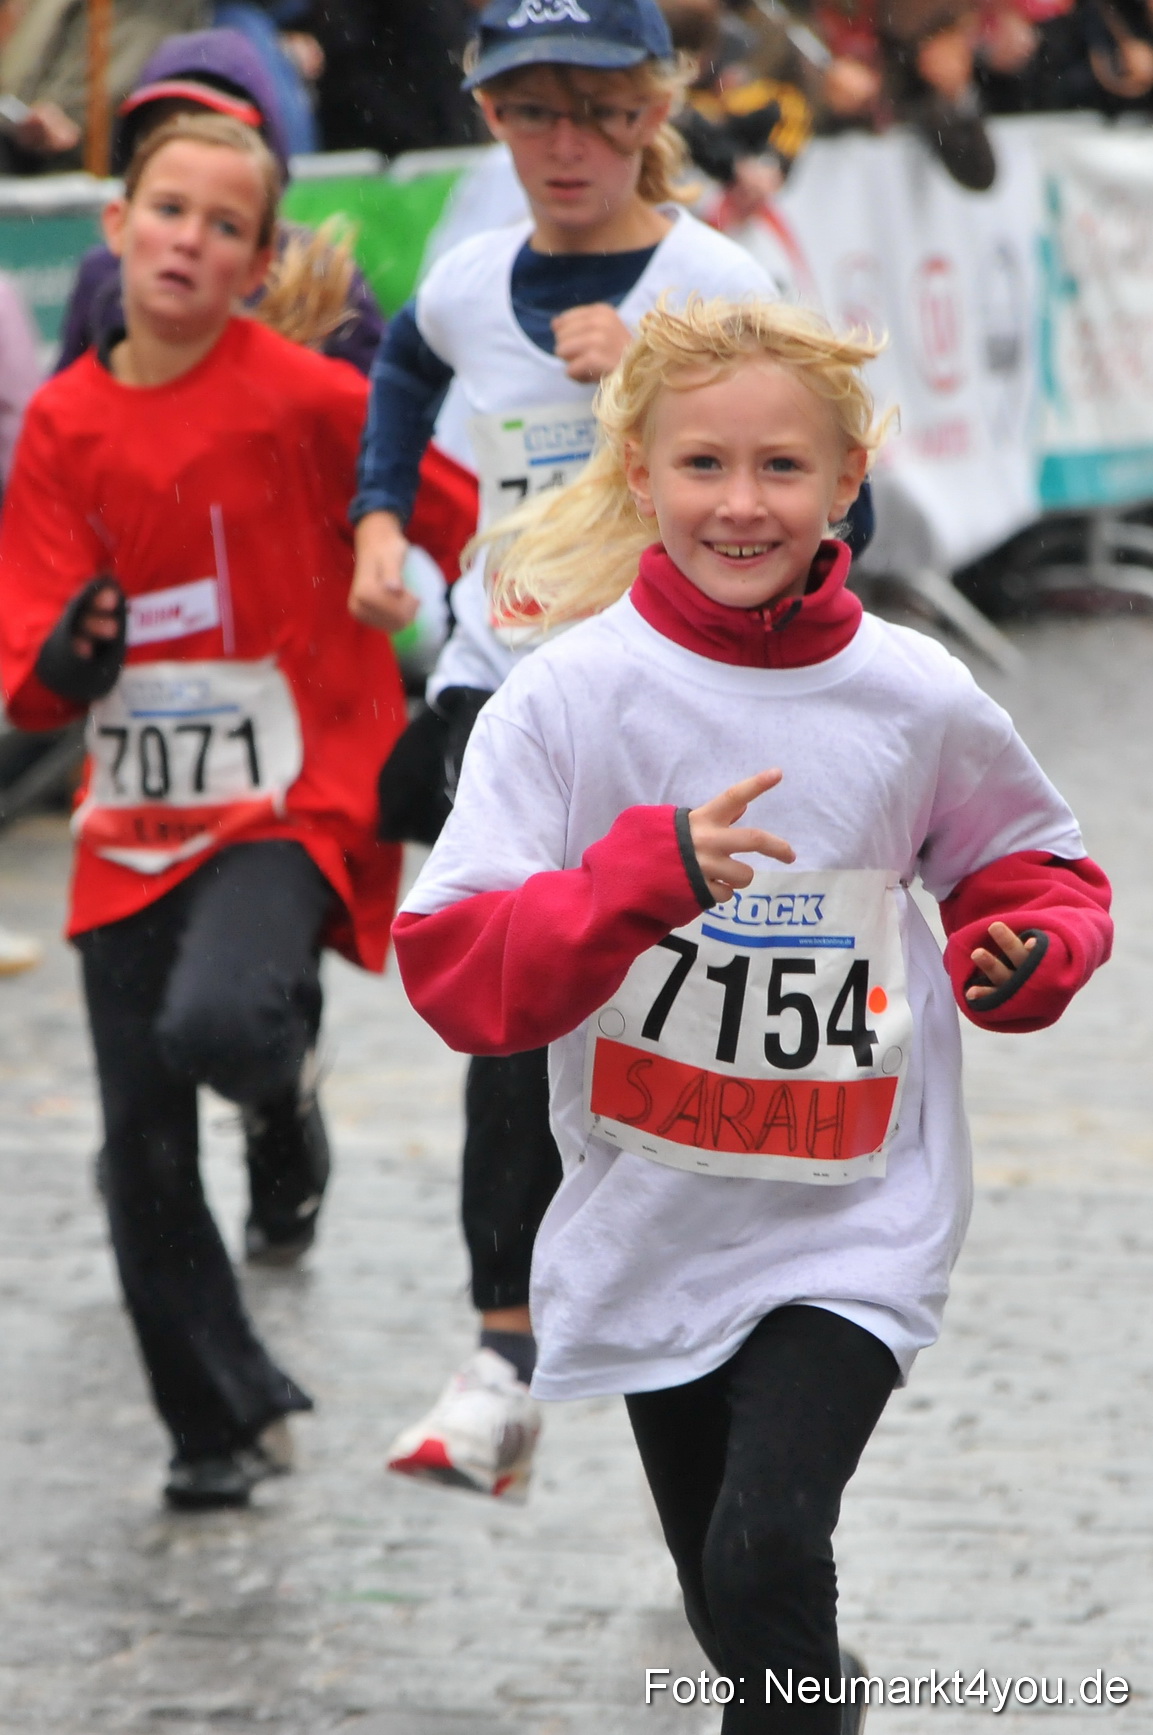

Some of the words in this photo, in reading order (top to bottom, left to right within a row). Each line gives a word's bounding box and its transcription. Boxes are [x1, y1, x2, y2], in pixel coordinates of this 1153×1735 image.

[98, 717, 261, 797] 7071
[640, 933, 879, 1070] 7154
[616, 1058, 846, 1159] SARAH
